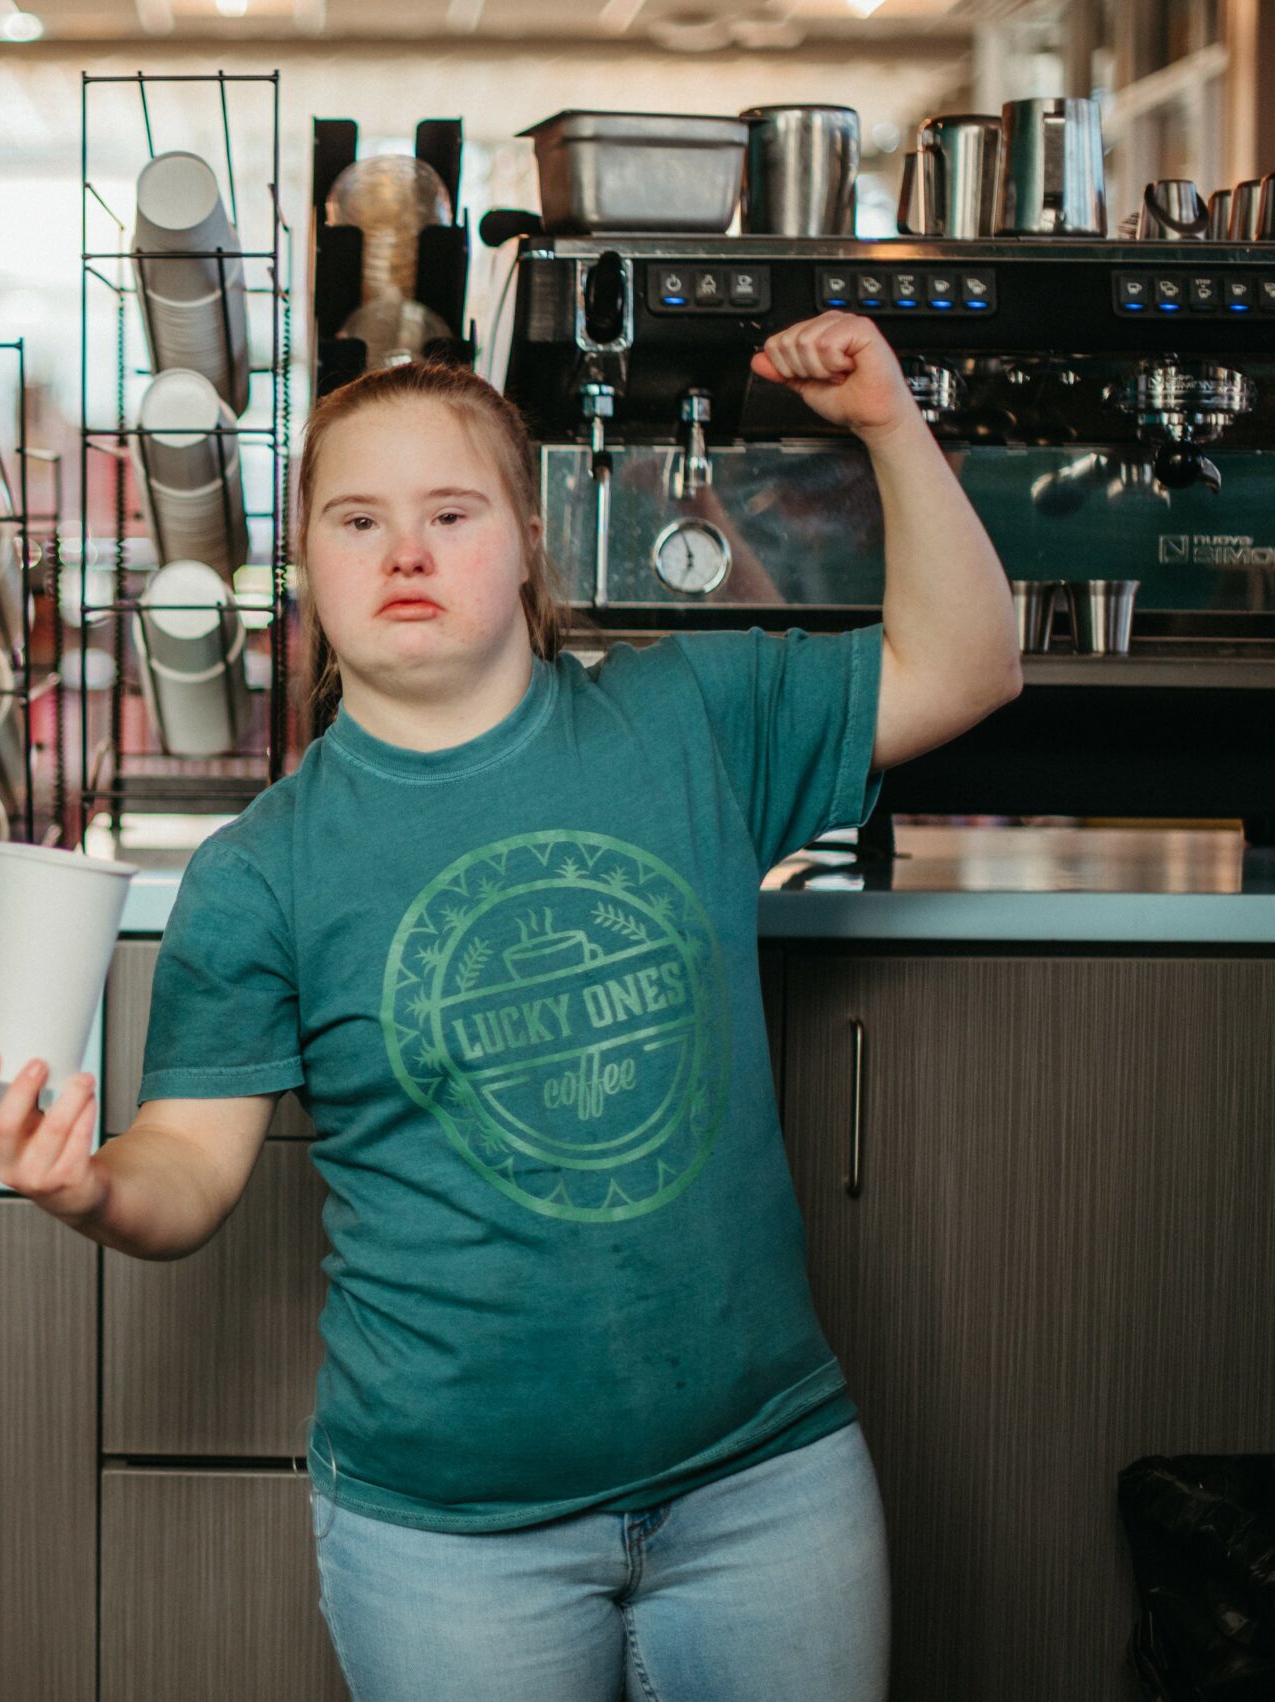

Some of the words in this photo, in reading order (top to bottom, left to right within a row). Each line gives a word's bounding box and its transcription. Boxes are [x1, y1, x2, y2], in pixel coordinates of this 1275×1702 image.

[451, 993, 573, 1061] LUCKY
[582, 962, 686, 1029] ONES
[543, 1050, 636, 1121] coffee
